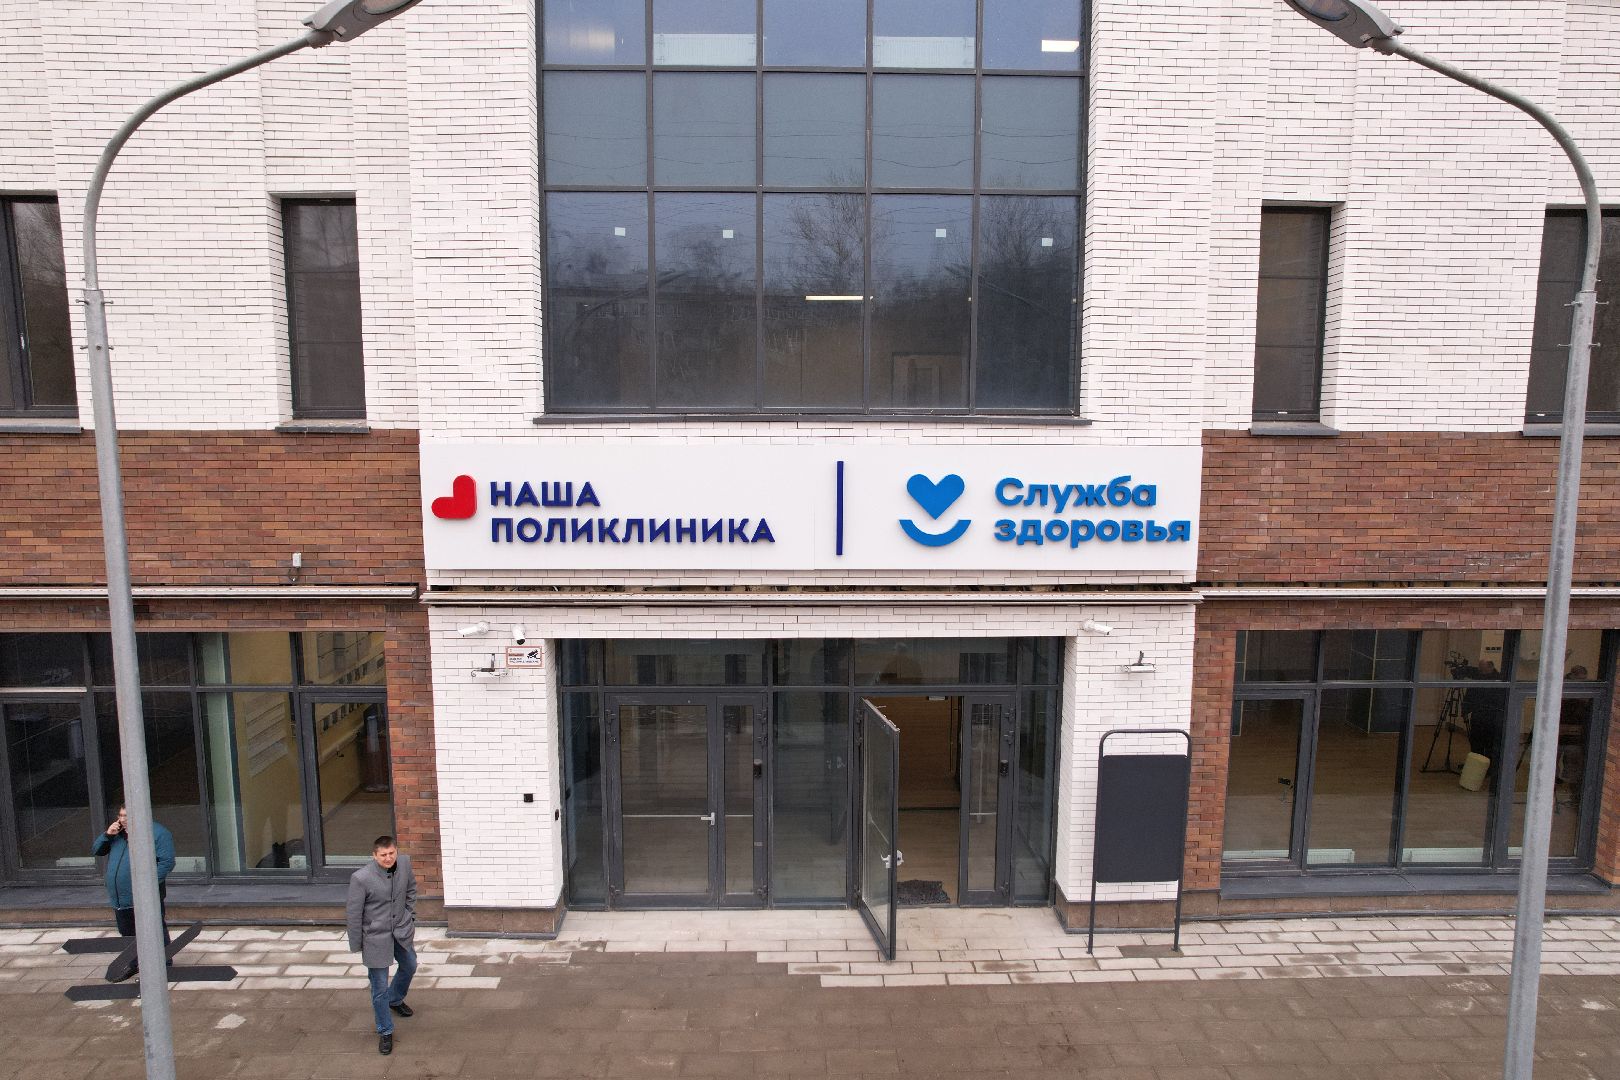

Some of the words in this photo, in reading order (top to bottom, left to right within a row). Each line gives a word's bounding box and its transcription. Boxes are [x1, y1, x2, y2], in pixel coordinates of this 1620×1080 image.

[490, 481, 600, 507] НАША
[994, 475, 1157, 514] Служба
[491, 517, 776, 543] ПОЛИКЛИНИКА
[994, 519, 1191, 549] здоровья
